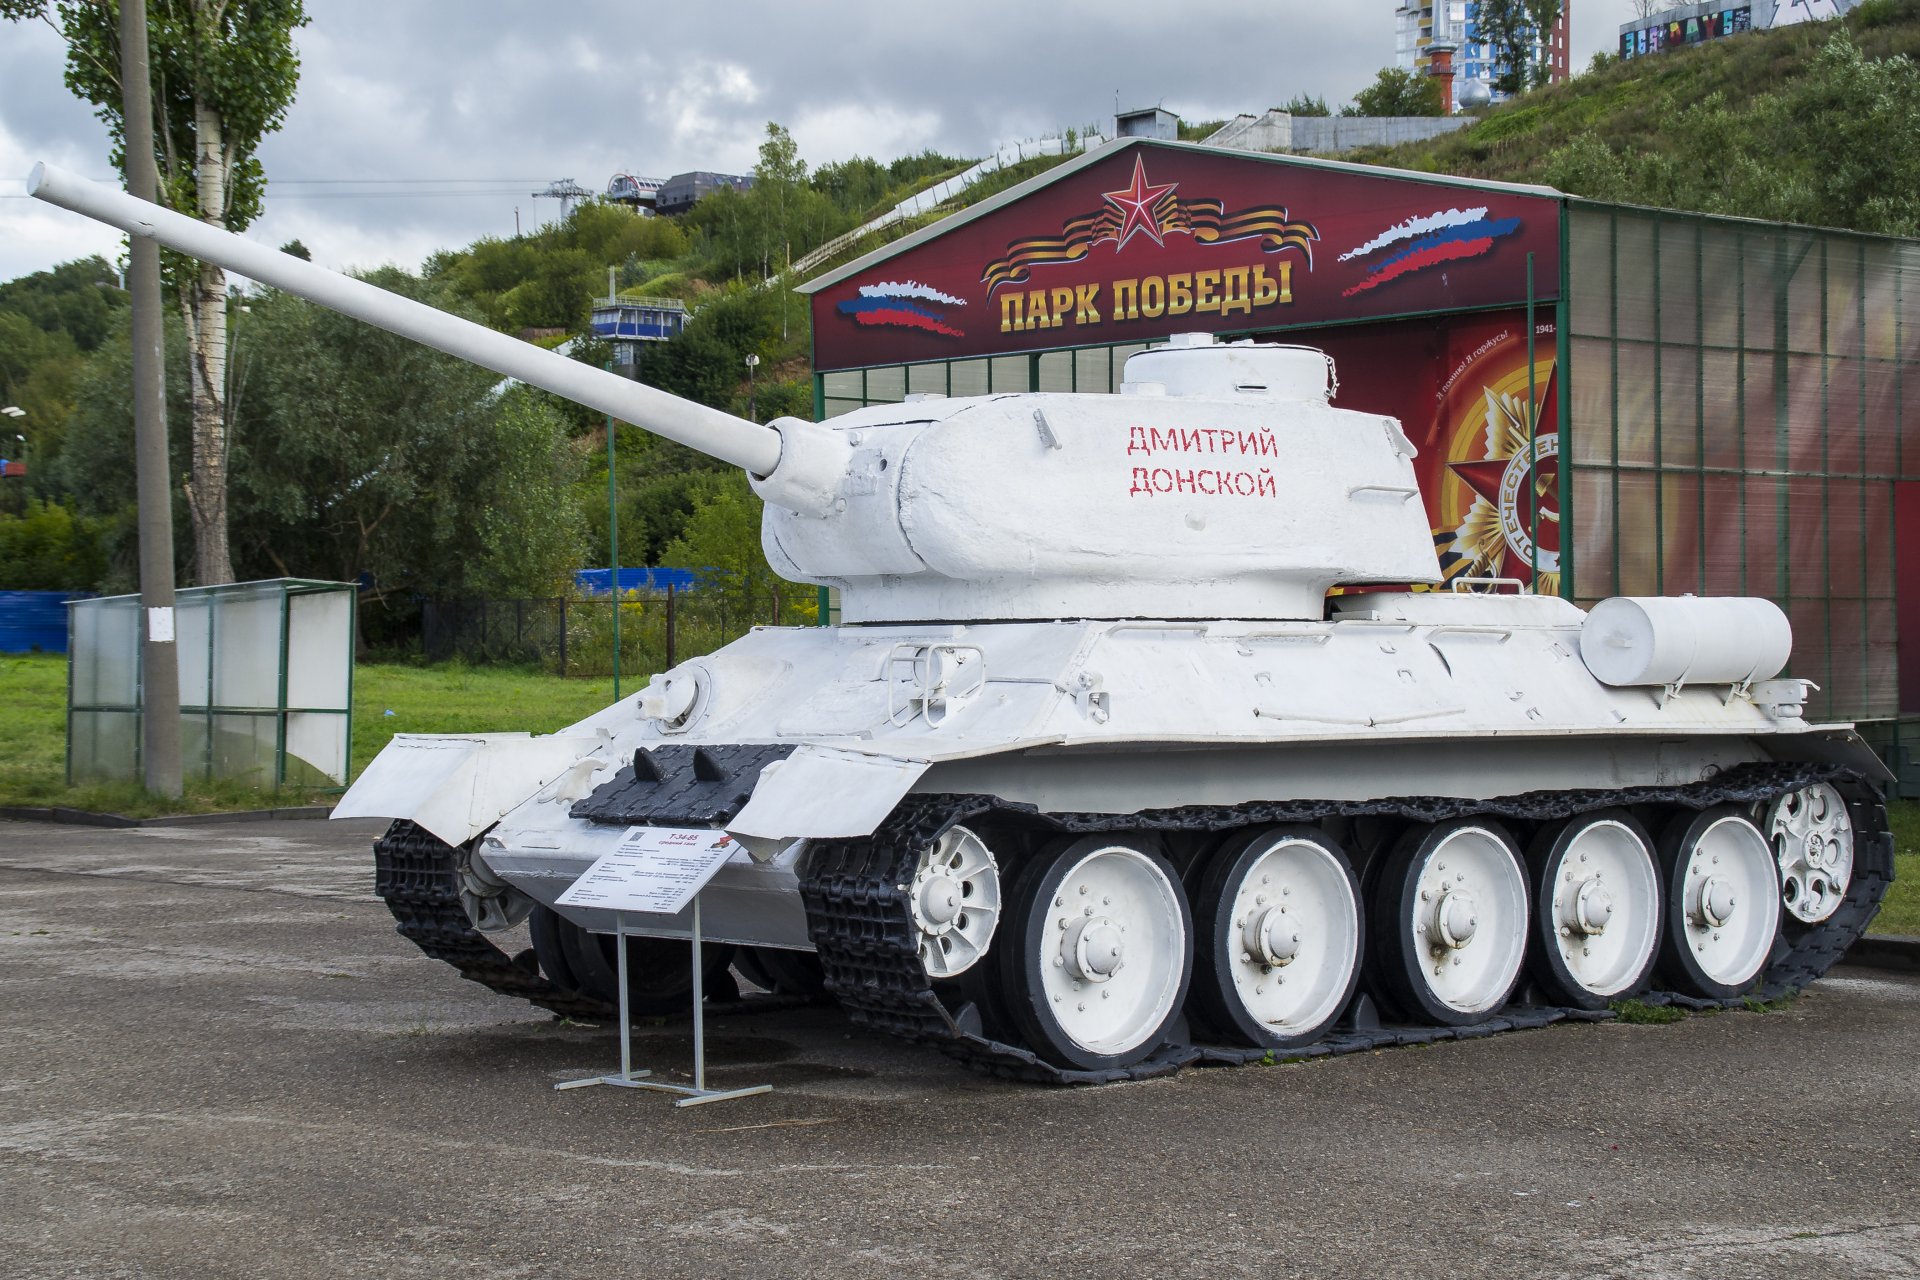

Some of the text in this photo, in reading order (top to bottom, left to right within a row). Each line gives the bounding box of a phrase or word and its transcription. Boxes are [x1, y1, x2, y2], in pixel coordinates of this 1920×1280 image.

[1000, 260, 1292, 332] ПАРК ПОБЕДЫ
[1436, 330, 1508, 400] Я помню! Я горжусь!
[1127, 426, 1278, 458] ДМИТРИЙ
[1129, 467, 1276, 498] ДОНСКОЙ
